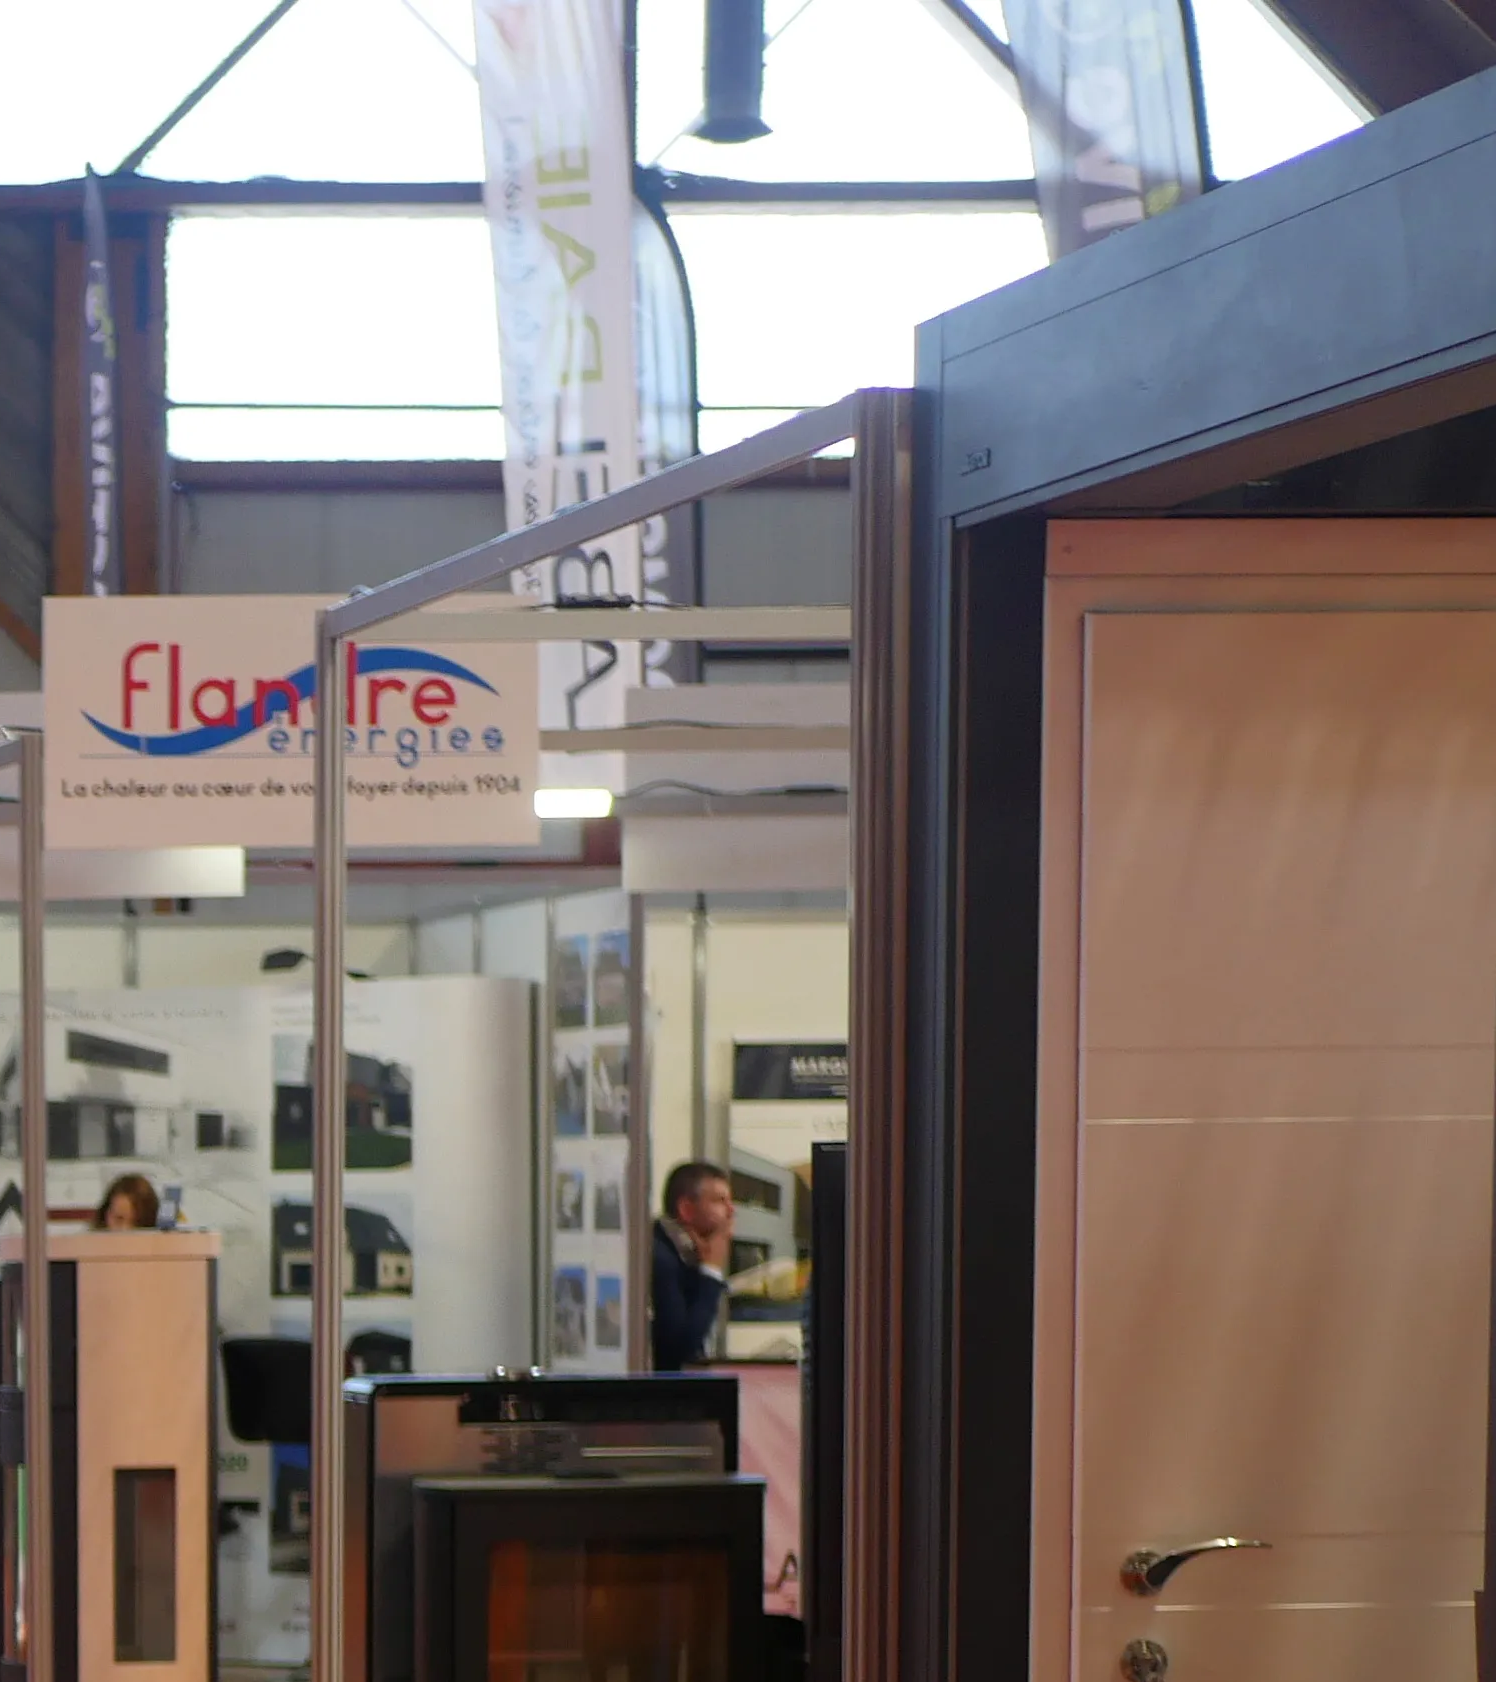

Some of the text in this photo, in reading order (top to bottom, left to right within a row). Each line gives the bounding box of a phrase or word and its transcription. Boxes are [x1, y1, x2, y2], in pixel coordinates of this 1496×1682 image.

[61, 778, 87, 798] La
[91, 777, 167, 798] chaleur
[172, 781, 199, 798] au
[260, 777, 285, 798] de
[401, 774, 470, 800] depuis
[473, 773, 522, 794] 1904
